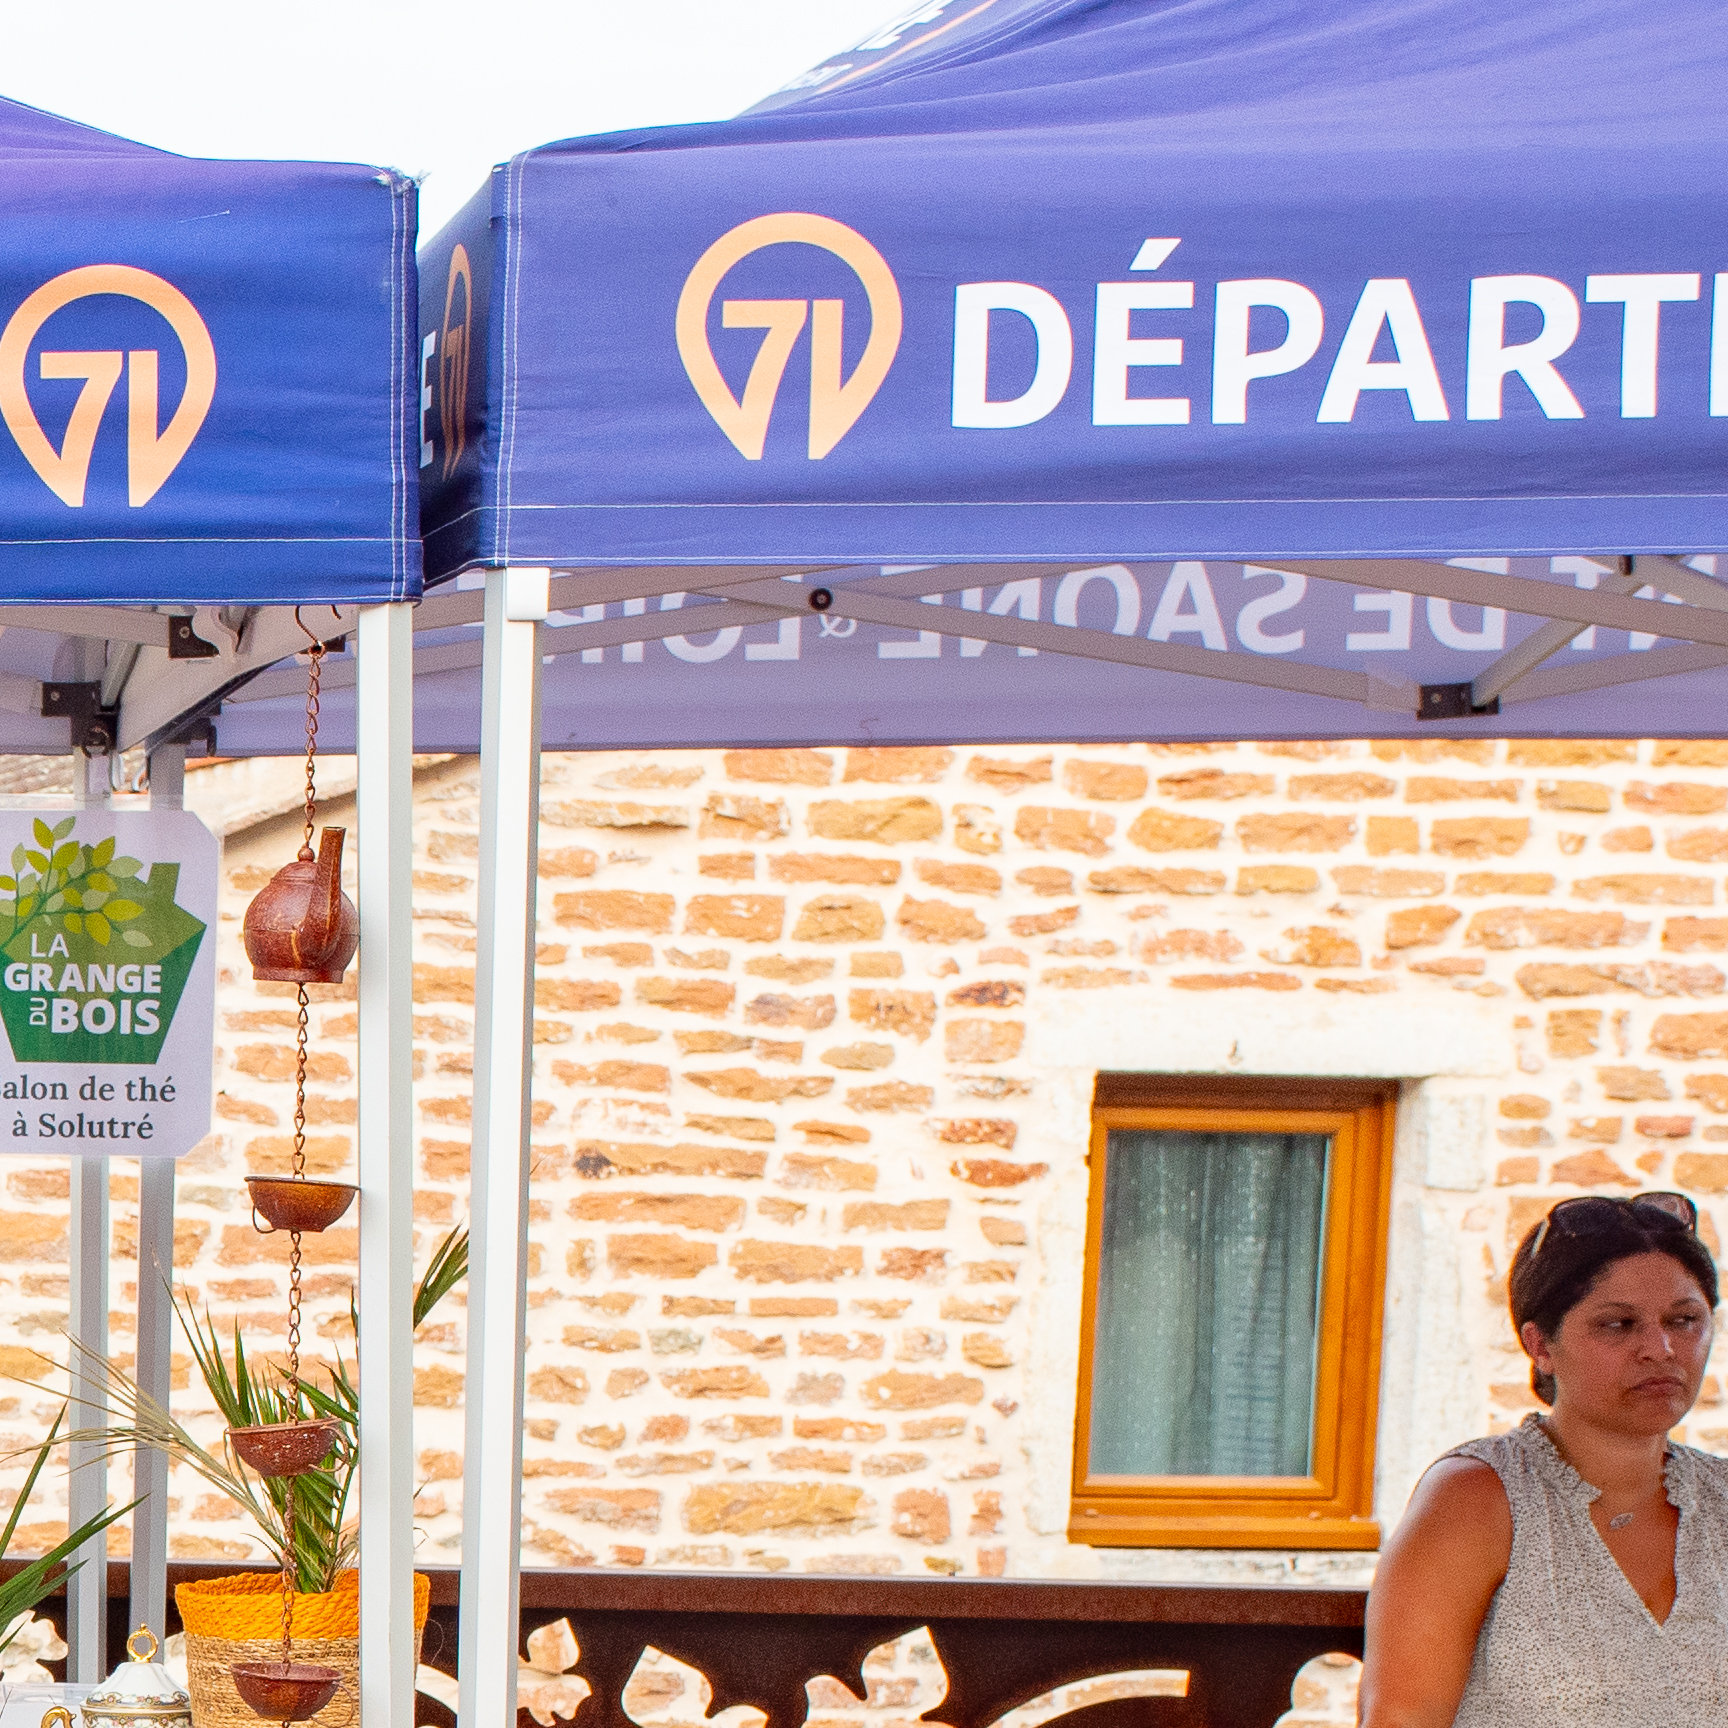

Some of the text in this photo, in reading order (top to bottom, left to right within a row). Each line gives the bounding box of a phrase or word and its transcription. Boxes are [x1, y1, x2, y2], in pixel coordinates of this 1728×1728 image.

[951, 239, 1728, 430] DÉPART
[30, 934, 69, 958] LA
[4, 963, 162, 993] GRANGE
[29, 997, 161, 1035] DU BOIS
[79, 1076, 115, 1101] de
[125, 1077, 176, 1102] thé
[12, 1111, 154, 1139] à Solutré
